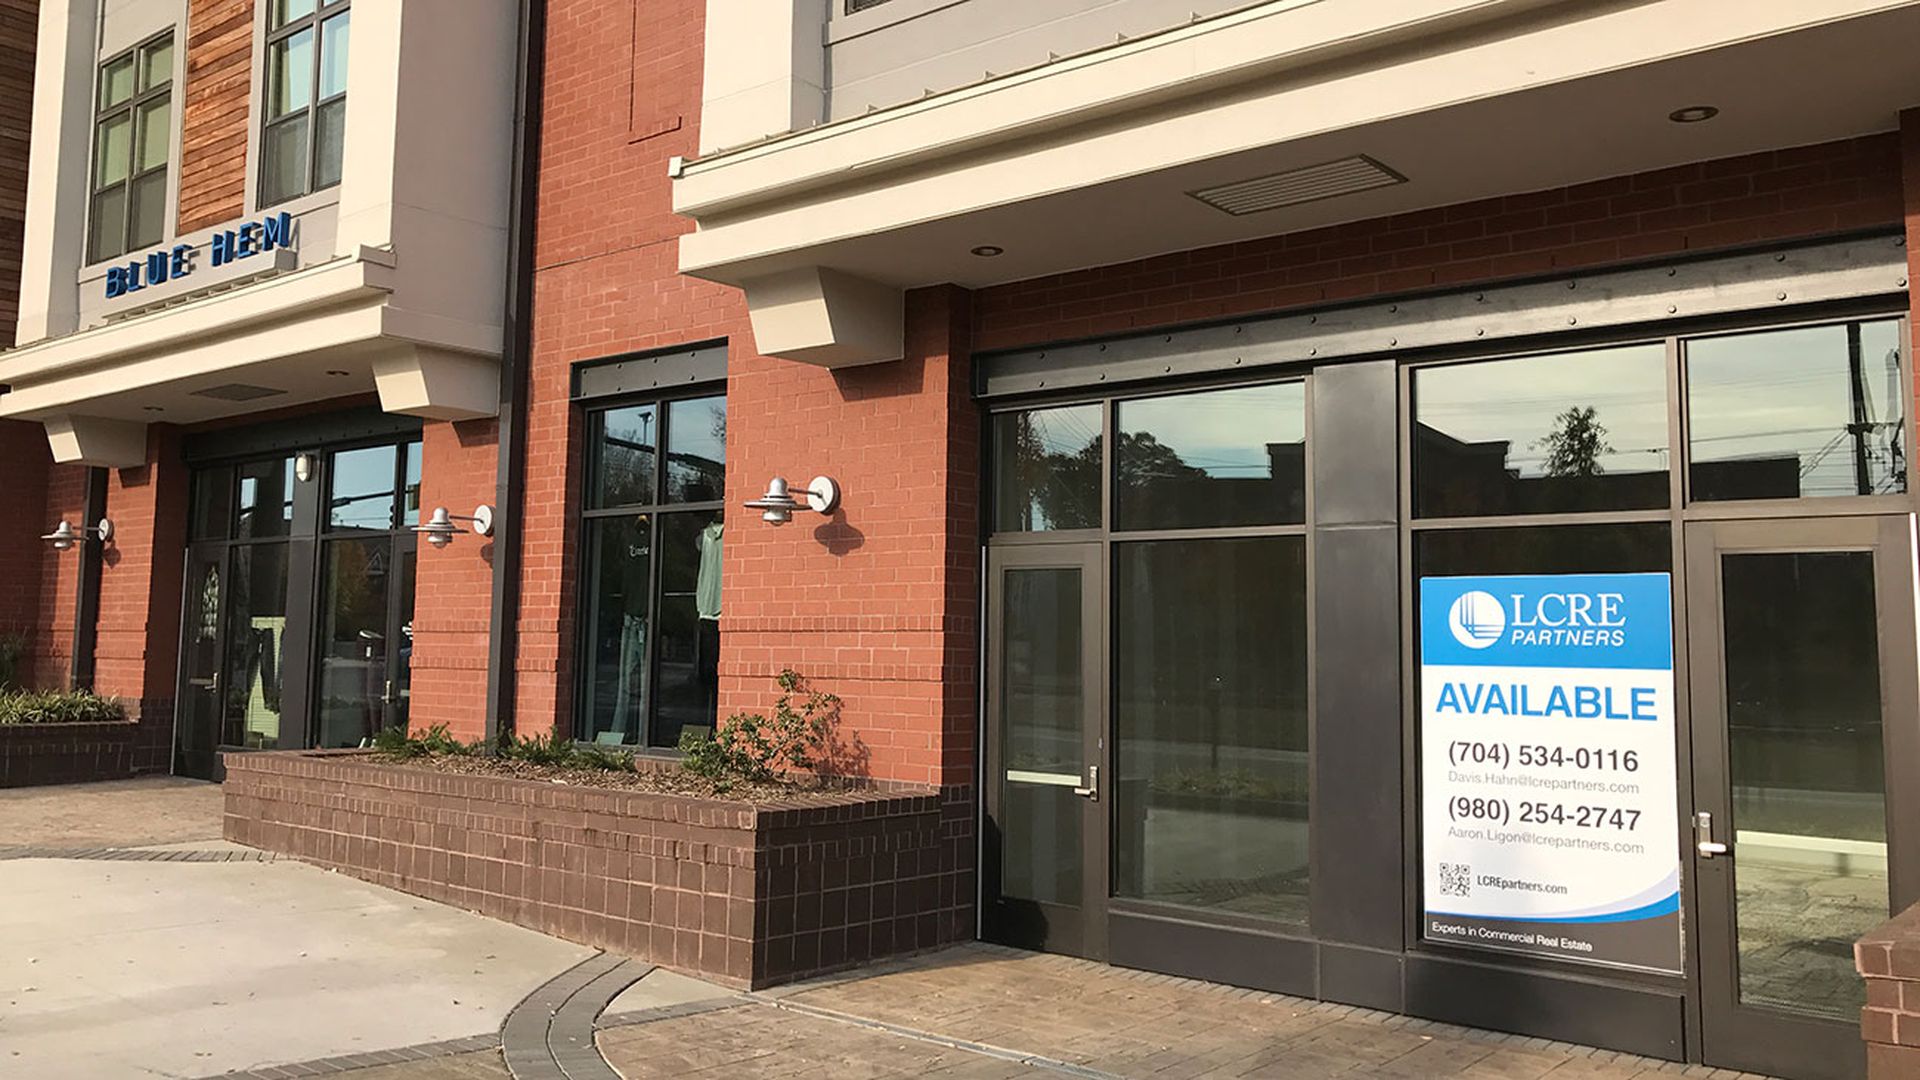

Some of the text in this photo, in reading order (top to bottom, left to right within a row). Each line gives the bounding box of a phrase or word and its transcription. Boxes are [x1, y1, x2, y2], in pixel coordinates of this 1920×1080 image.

[106, 212, 291, 298] BLUE HEM
[1511, 593, 1626, 627] LCRE
[1511, 630, 1625, 646] PARTNERS
[1436, 683, 1657, 721] AVAILABLE
[1449, 740, 1639, 772] (704) 534-0116
[1448, 771, 1640, 794] Davis.Hahn@lcrepartners.com
[1449, 796, 1641, 831] (980) 254-2747
[1448, 826, 1645, 854] Aaron.Ligon@lcrepartners.com
[1477, 875, 1568, 894] LCREpartners.com
[1432, 922, 1593, 952] Experts in Commercial Real Estate
